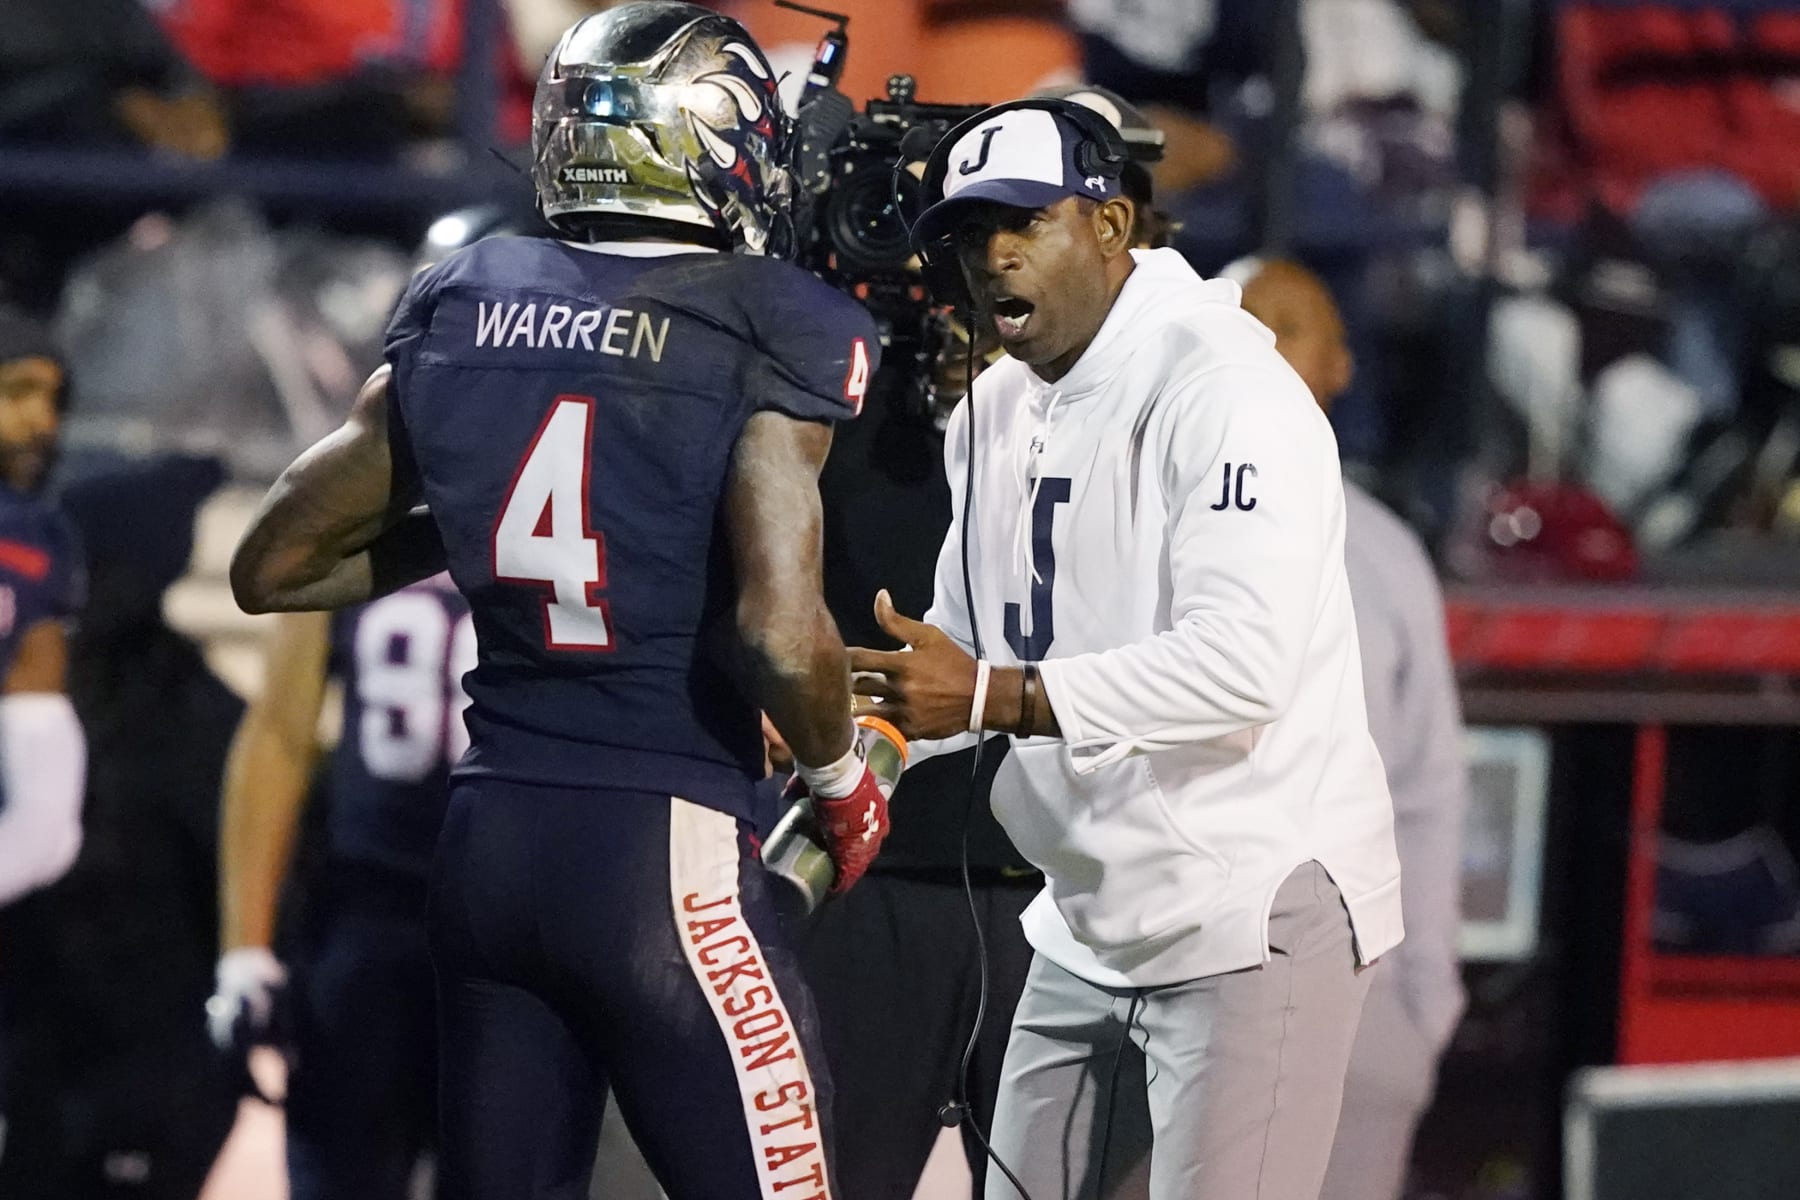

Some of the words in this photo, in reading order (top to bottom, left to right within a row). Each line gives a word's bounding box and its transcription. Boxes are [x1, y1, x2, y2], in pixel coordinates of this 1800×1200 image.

[563, 168, 627, 183] XENITH
[959, 125, 1003, 175] J
[476, 302, 670, 362] WARREN
[844, 337, 871, 416] 4
[1210, 462, 1258, 512] JC
[493, 395, 616, 652] 4
[1004, 477, 1071, 661] J
[683, 893, 796, 1071] JACKSON
[754, 1080, 826, 1200] STAT
